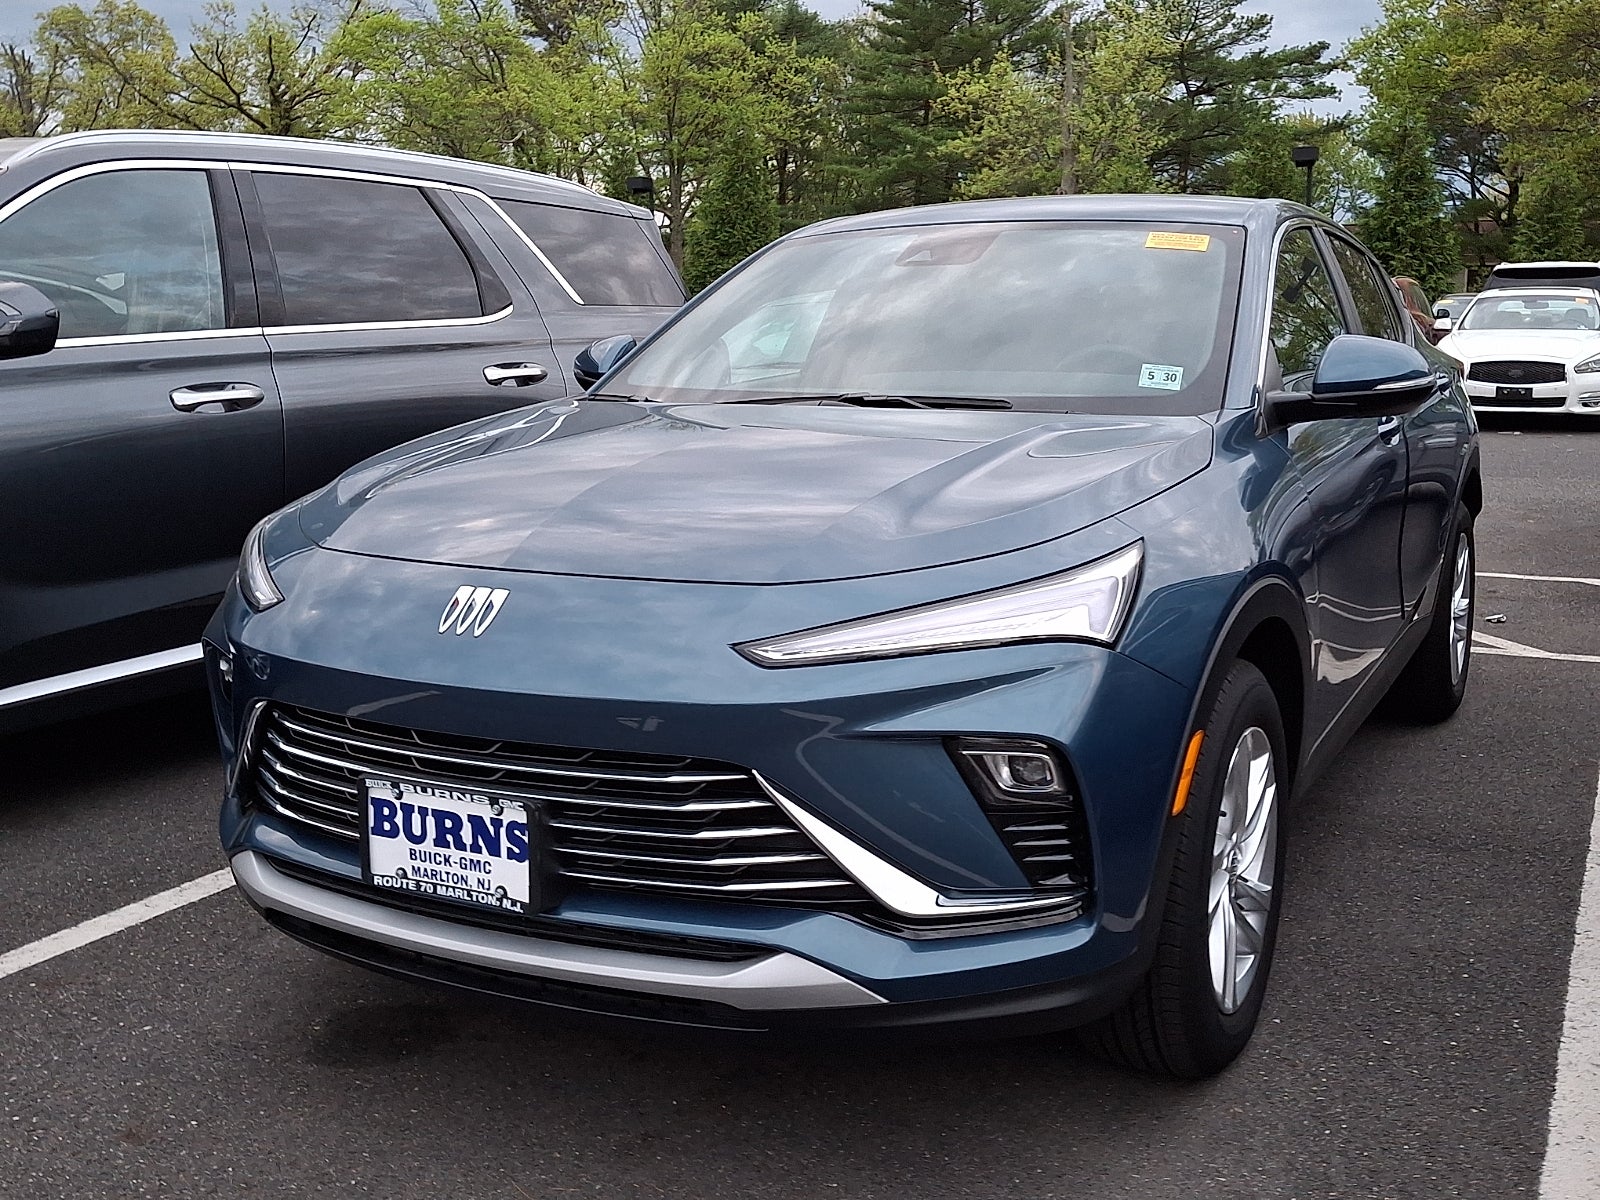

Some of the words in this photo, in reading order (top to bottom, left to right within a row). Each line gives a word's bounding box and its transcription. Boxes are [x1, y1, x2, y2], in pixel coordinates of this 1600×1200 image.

[1147, 371, 1155, 380] 5
[1163, 372, 1177, 382] 30
[399, 783, 490, 806] BURNS
[370, 796, 529, 863] BURNS
[409, 848, 492, 875] BUICK-GMC
[373, 875, 417, 891] ROUTE
[419, 882, 434, 894] 70
[477, 878, 491, 891] NJ
